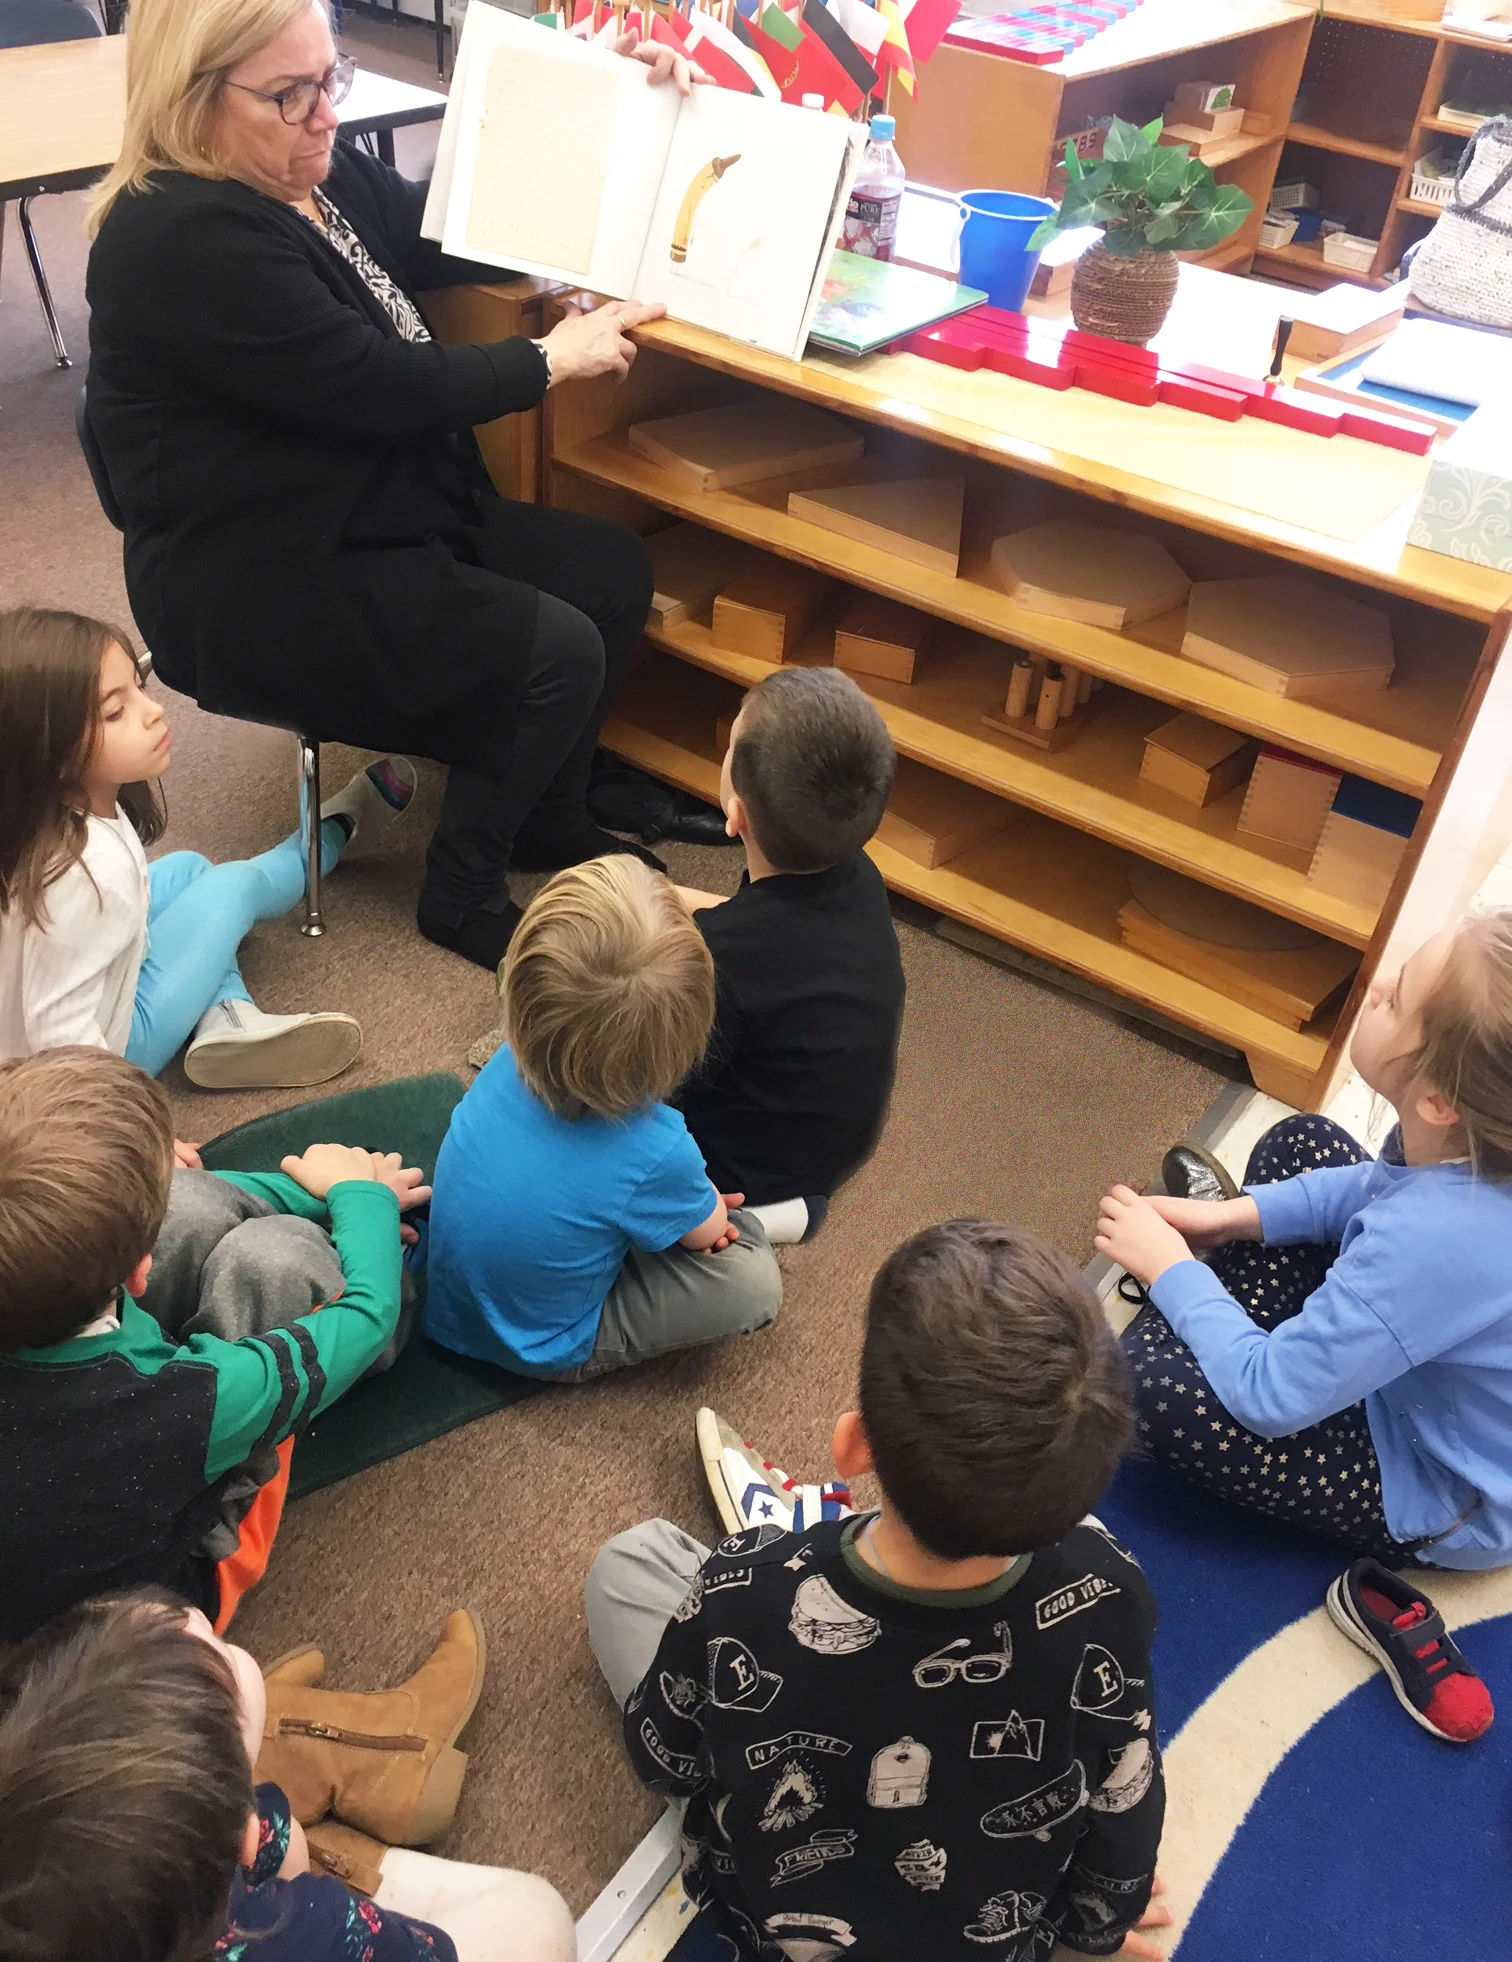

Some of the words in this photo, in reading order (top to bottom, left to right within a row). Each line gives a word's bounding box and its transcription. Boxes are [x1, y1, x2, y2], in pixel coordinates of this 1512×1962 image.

[860, 204, 881, 214] PURE
[723, 1534, 746, 1552] E
[1043, 1591, 1076, 1618] GOOD
[729, 1653, 755, 1691] E
[1093, 1660, 1119, 1697] E
[754, 1735, 839, 1762] NATURE
